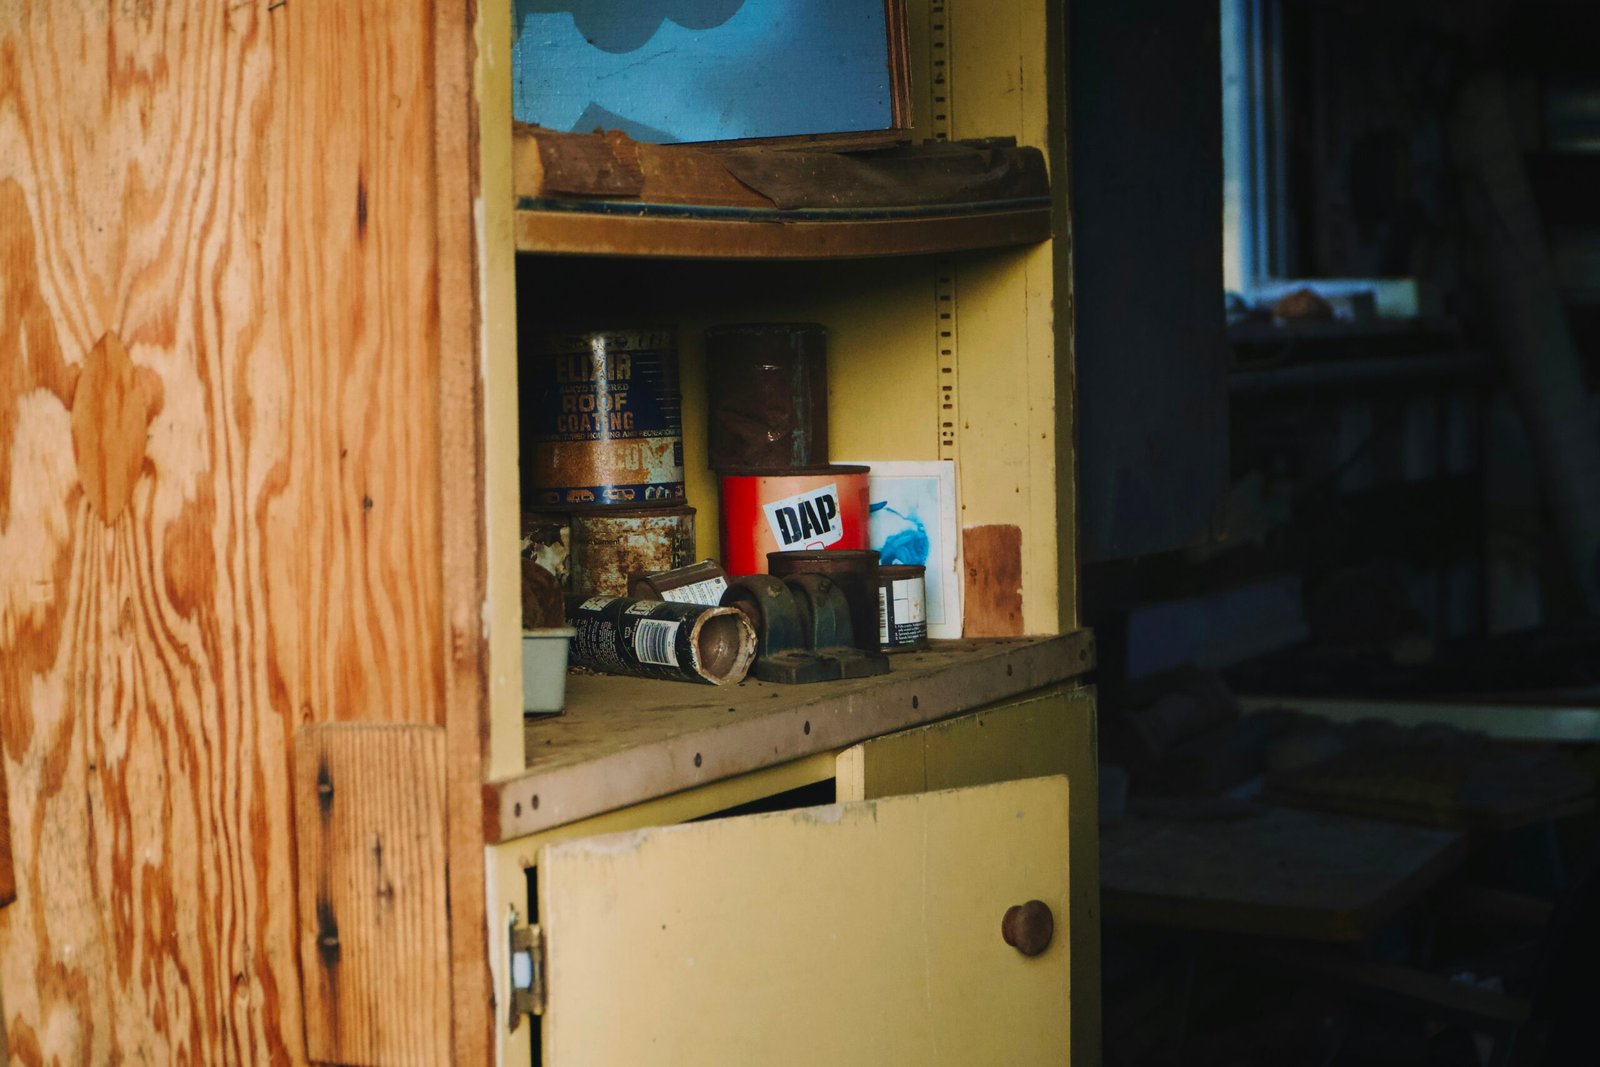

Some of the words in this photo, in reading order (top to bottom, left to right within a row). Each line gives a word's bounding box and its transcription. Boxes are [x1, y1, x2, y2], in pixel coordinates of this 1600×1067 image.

[557, 353, 631, 381] ELIXIR
[562, 393, 627, 413] ROOF
[558, 411, 634, 432] COATING
[774, 493, 837, 546] DAP
